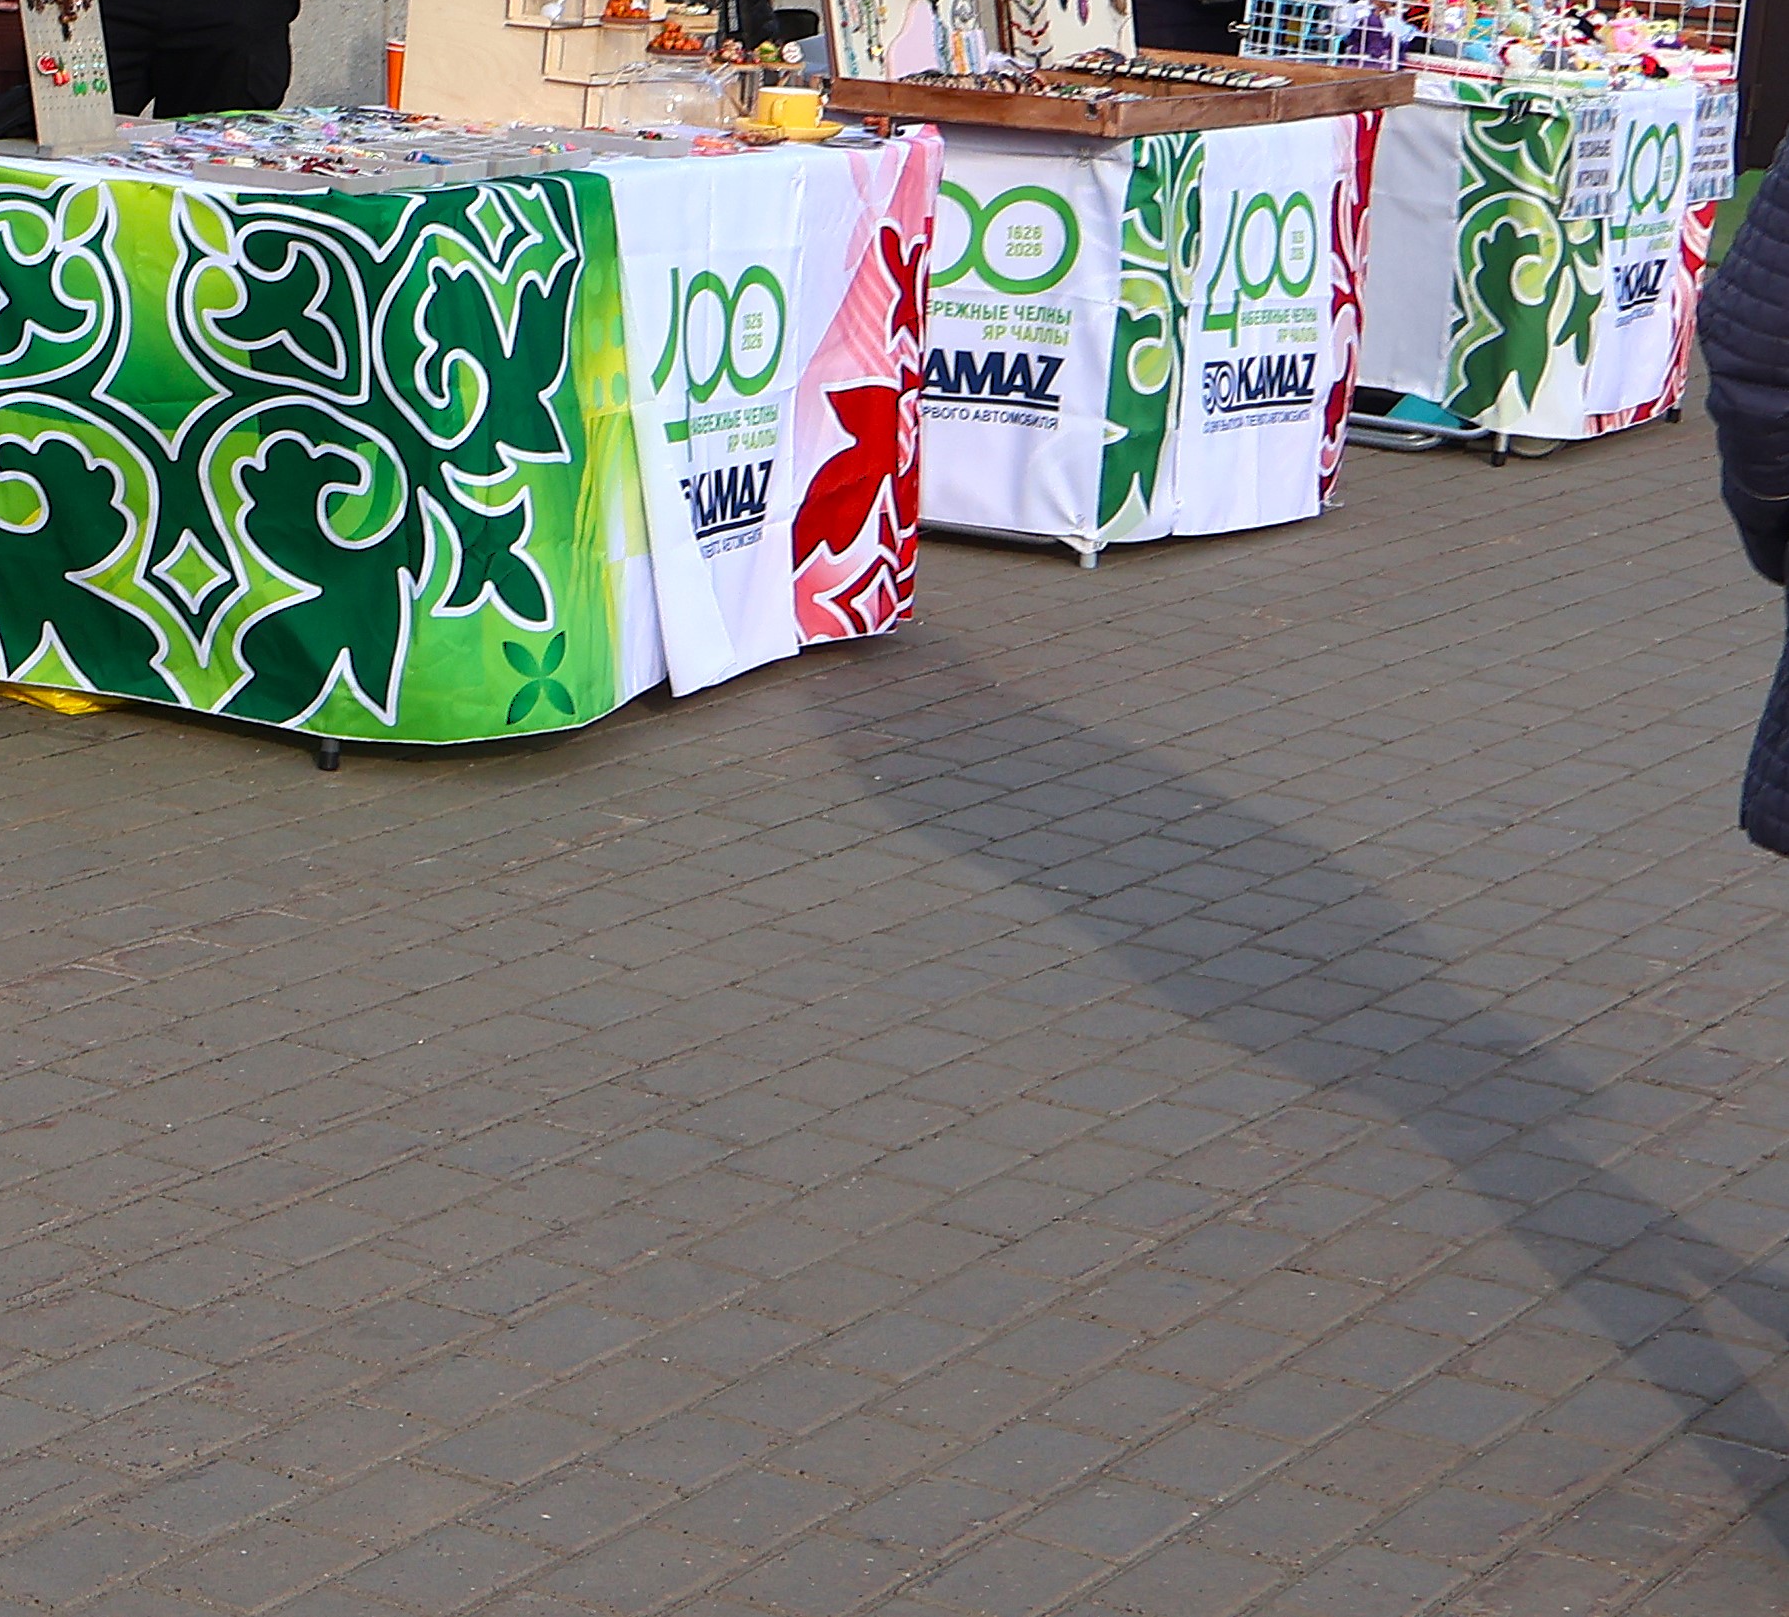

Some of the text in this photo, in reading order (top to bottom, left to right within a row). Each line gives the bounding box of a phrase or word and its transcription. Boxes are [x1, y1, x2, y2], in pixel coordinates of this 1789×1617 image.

[930, 180, 1080, 295] 00
[1202, 190, 1317, 348] 400
[926, 299, 1072, 325] ЕРЕЖНЫЕ ЧЕЛНЫ
[982, 325, 1007, 340] ЯР
[922, 348, 1065, 403] AMAZ
[922, 405, 970, 421] РВОГО
